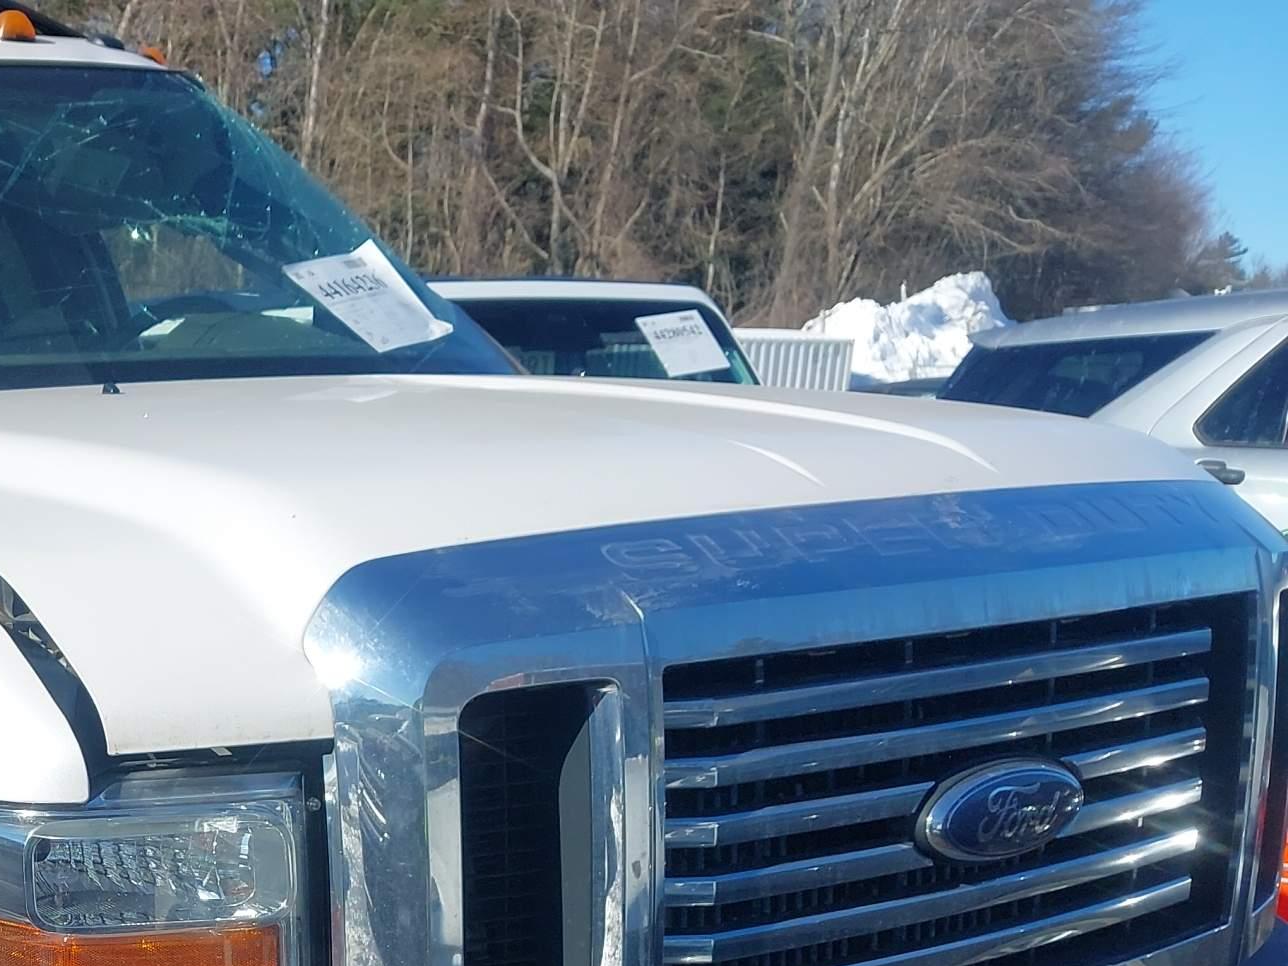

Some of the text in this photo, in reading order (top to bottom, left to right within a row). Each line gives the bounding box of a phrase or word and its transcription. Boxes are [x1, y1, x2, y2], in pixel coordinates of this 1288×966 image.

[318, 272, 388, 300] 44164236
[600, 500, 1004, 583] SUPER
[976, 782, 1062, 844] Ford
